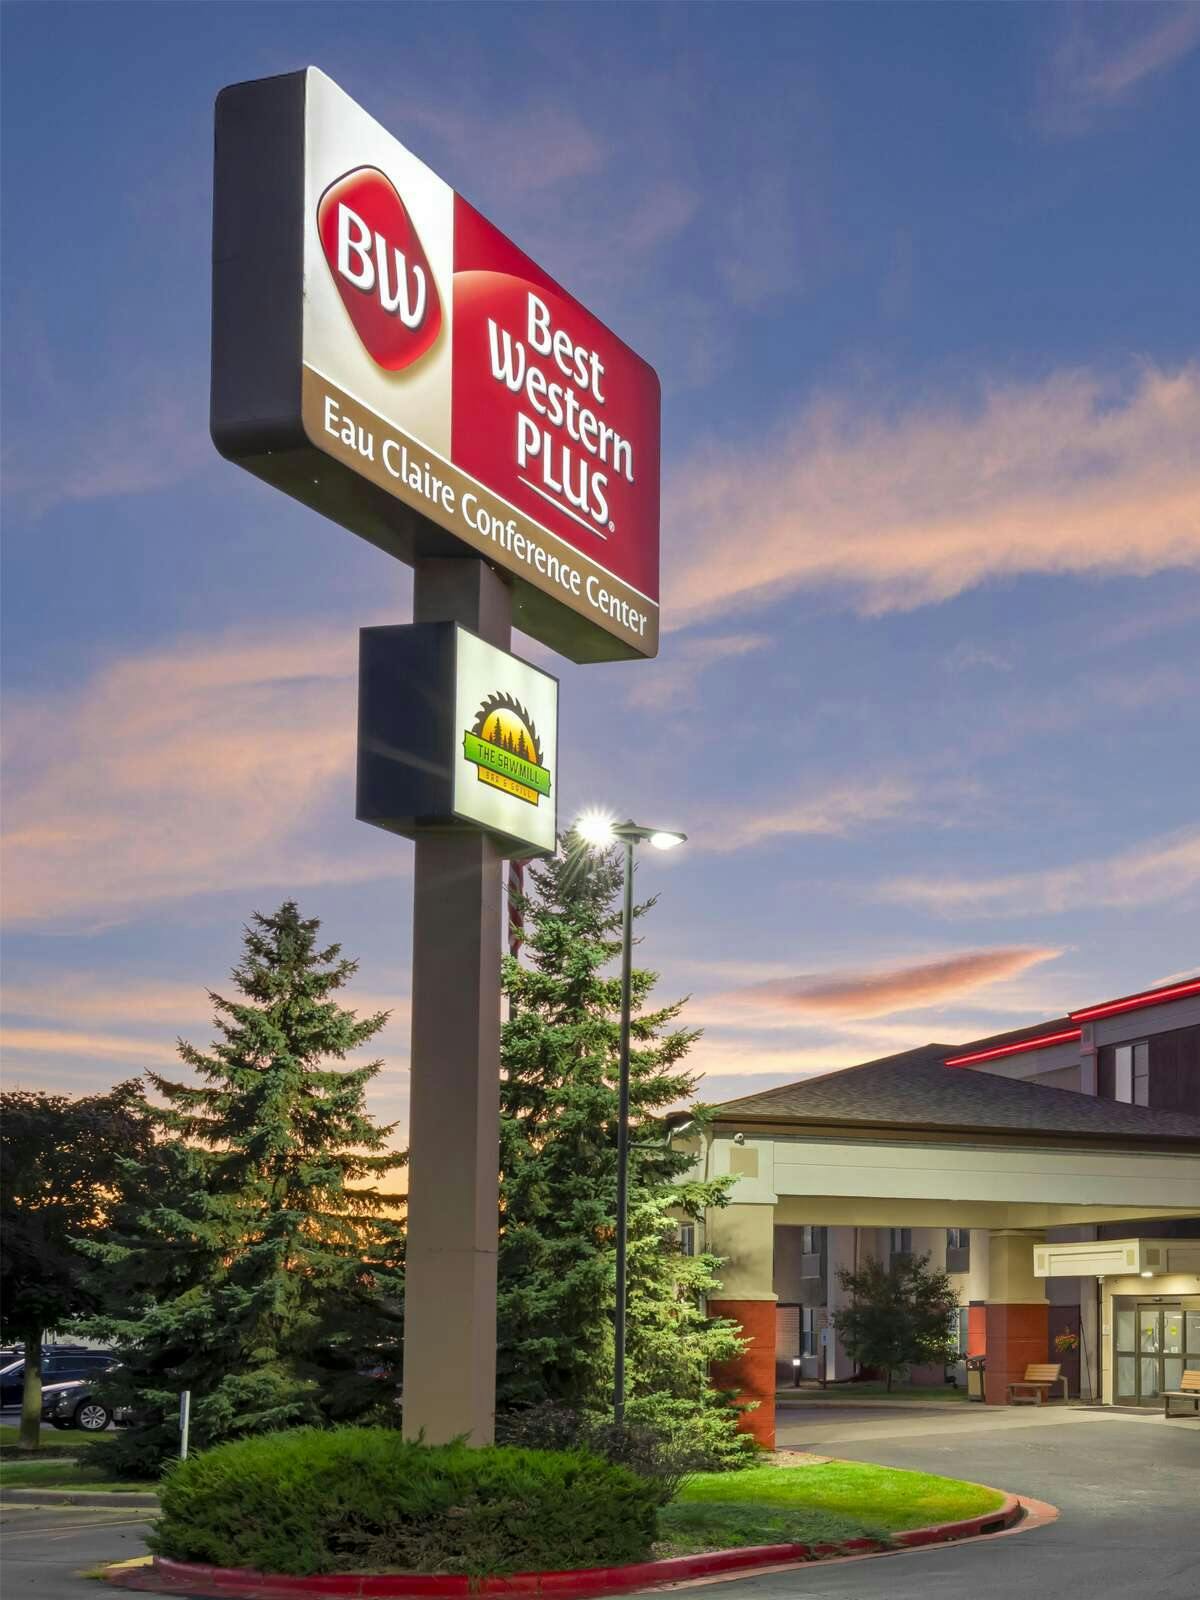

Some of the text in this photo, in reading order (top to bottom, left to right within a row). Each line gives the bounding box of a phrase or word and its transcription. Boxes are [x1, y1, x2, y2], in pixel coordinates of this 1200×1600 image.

[337, 201, 427, 329] BW
[487, 317, 635, 484] Western
[527, 291, 606, 404] Best
[324, 395, 648, 637] Eau Claire Conference Center
[516, 411, 610, 525] PLUS
[478, 743, 540, 785] THE SAWMILL
